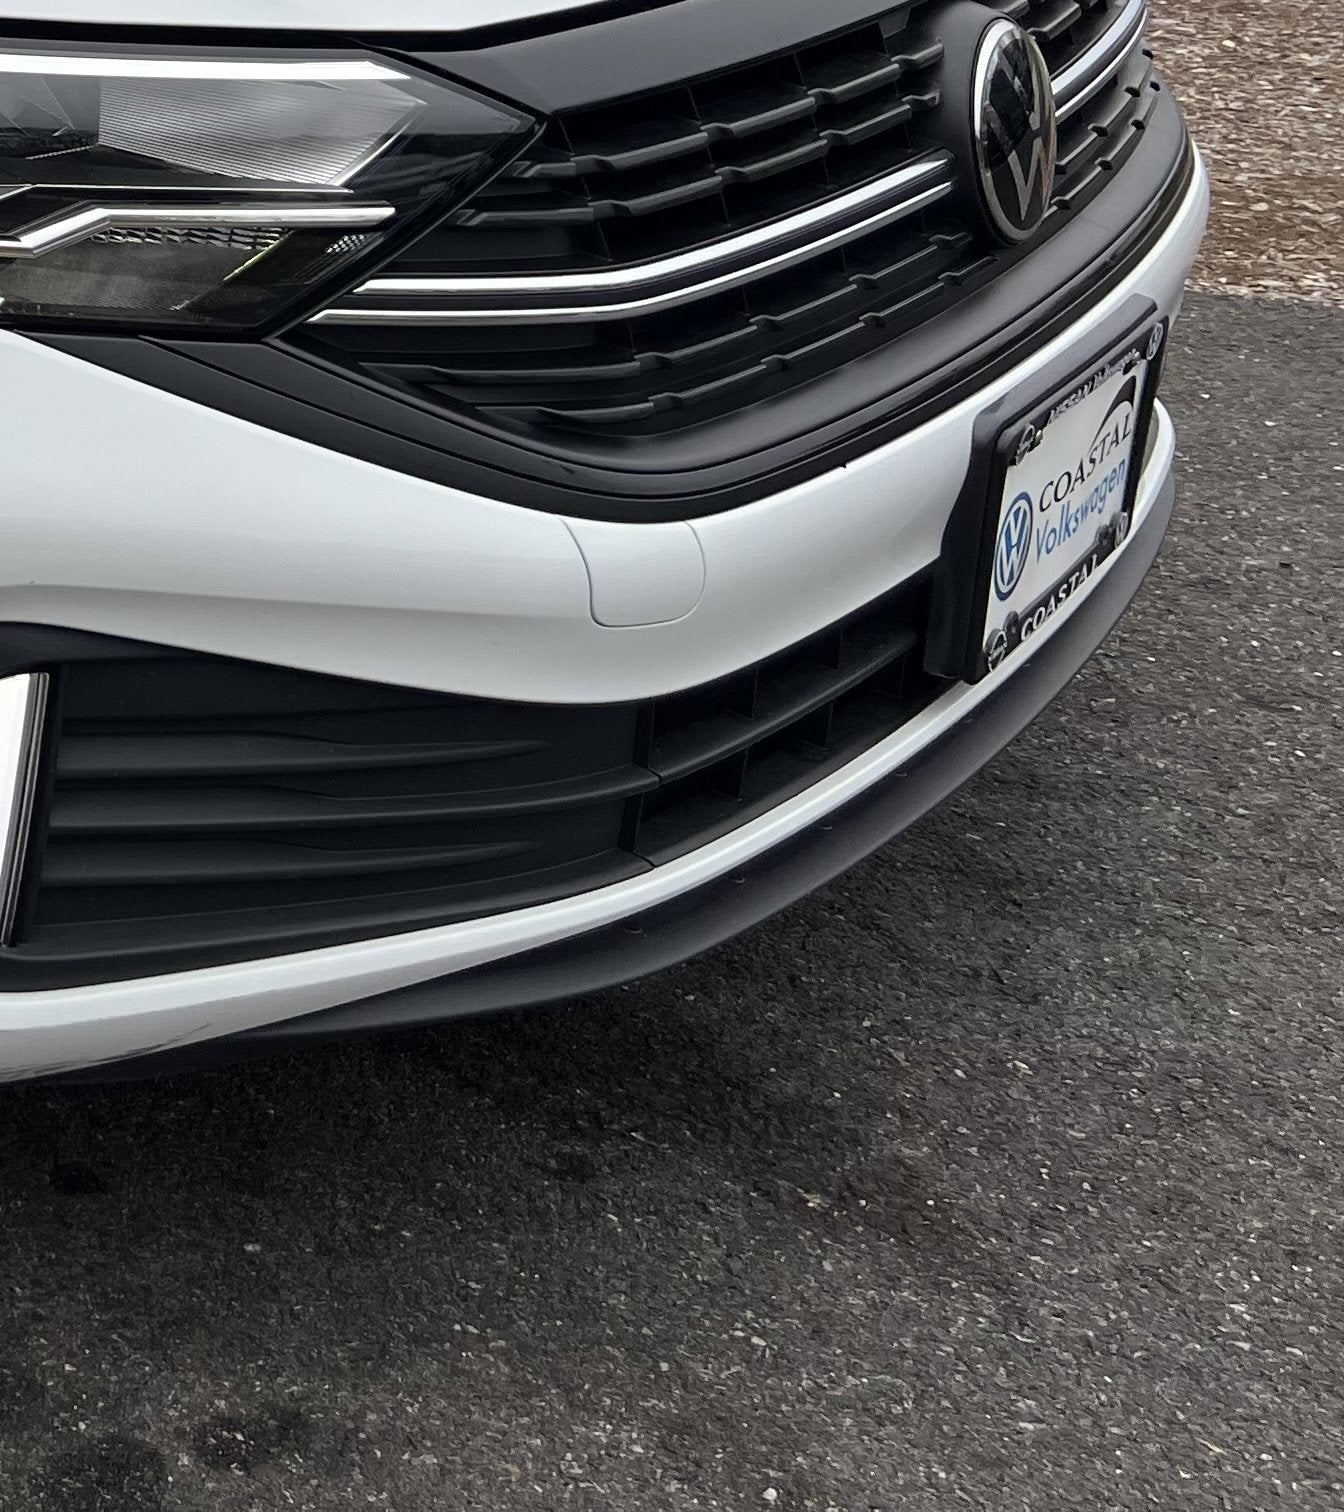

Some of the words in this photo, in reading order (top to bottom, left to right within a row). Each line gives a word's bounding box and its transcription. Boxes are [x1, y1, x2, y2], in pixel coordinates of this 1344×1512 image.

[1036, 459, 1127, 564] Volkswagen
[1039, 412, 1132, 513] COASTAL
[1021, 553, 1099, 640] COASTAL
